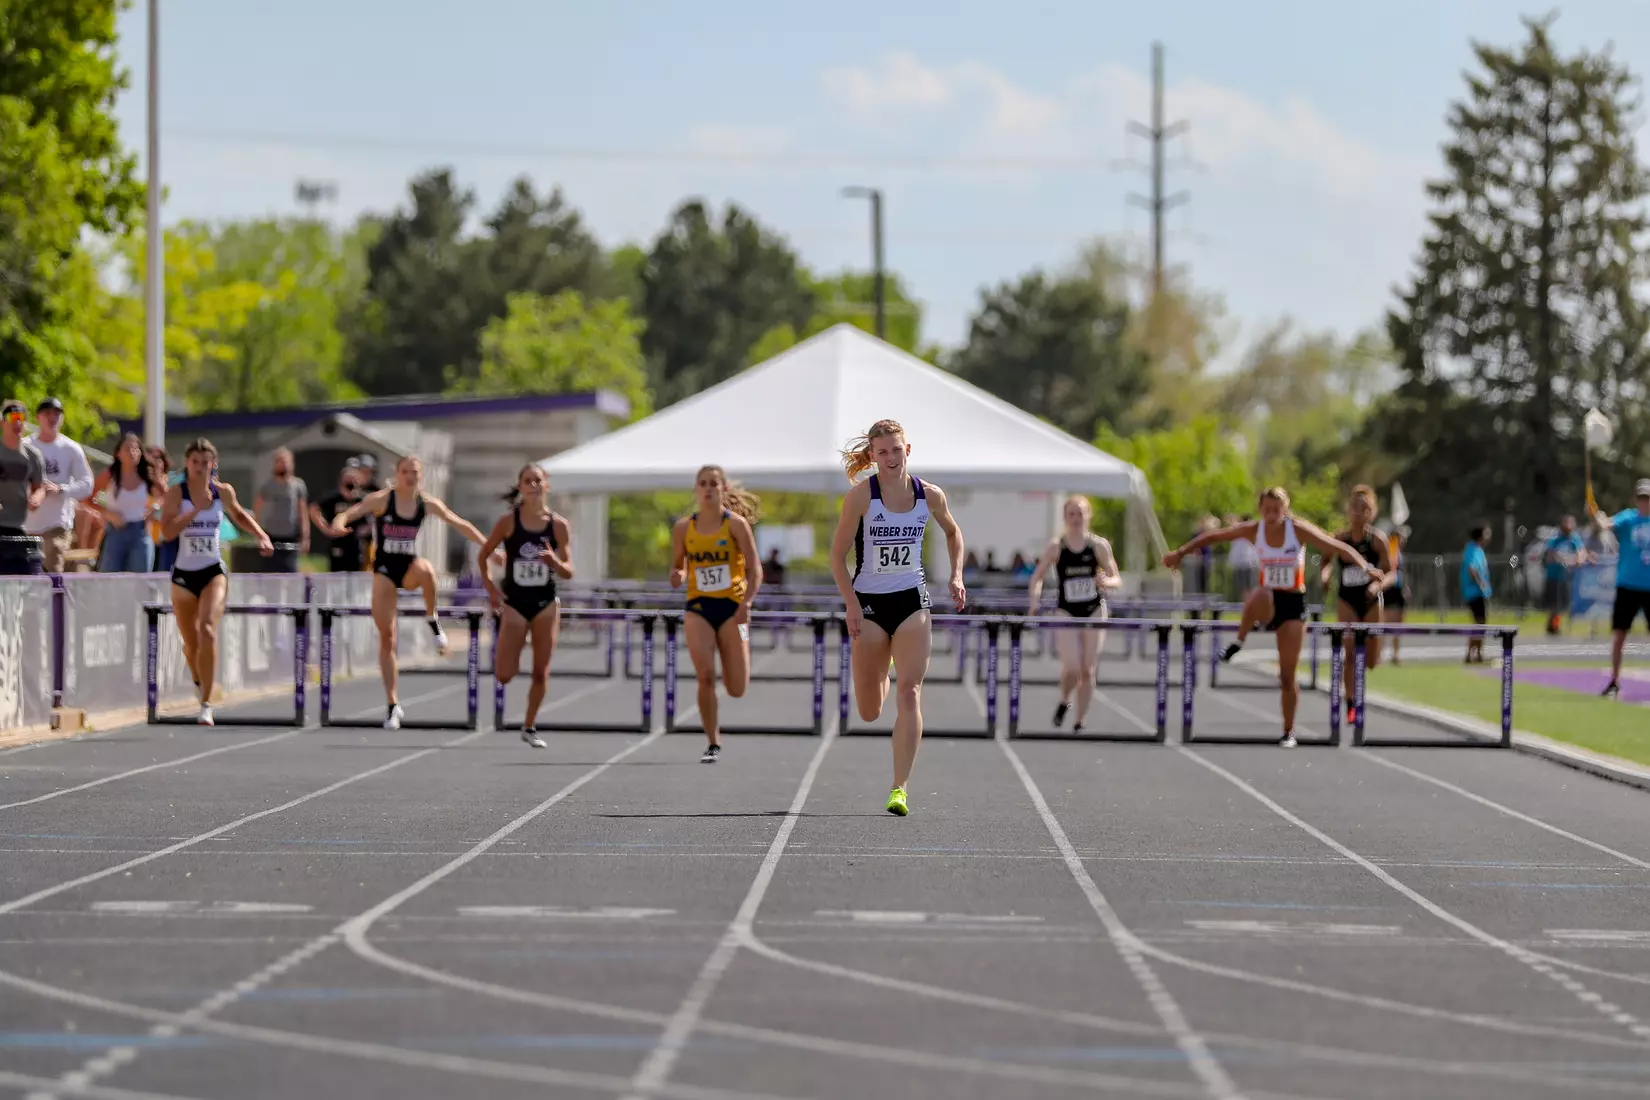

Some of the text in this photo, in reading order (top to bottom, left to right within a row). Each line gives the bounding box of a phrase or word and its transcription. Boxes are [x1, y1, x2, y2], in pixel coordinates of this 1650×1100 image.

[870, 526, 900, 536] WEBER
[190, 538, 212, 552] 524
[880, 546, 910, 566] 542
[701, 568, 722, 585] 357
